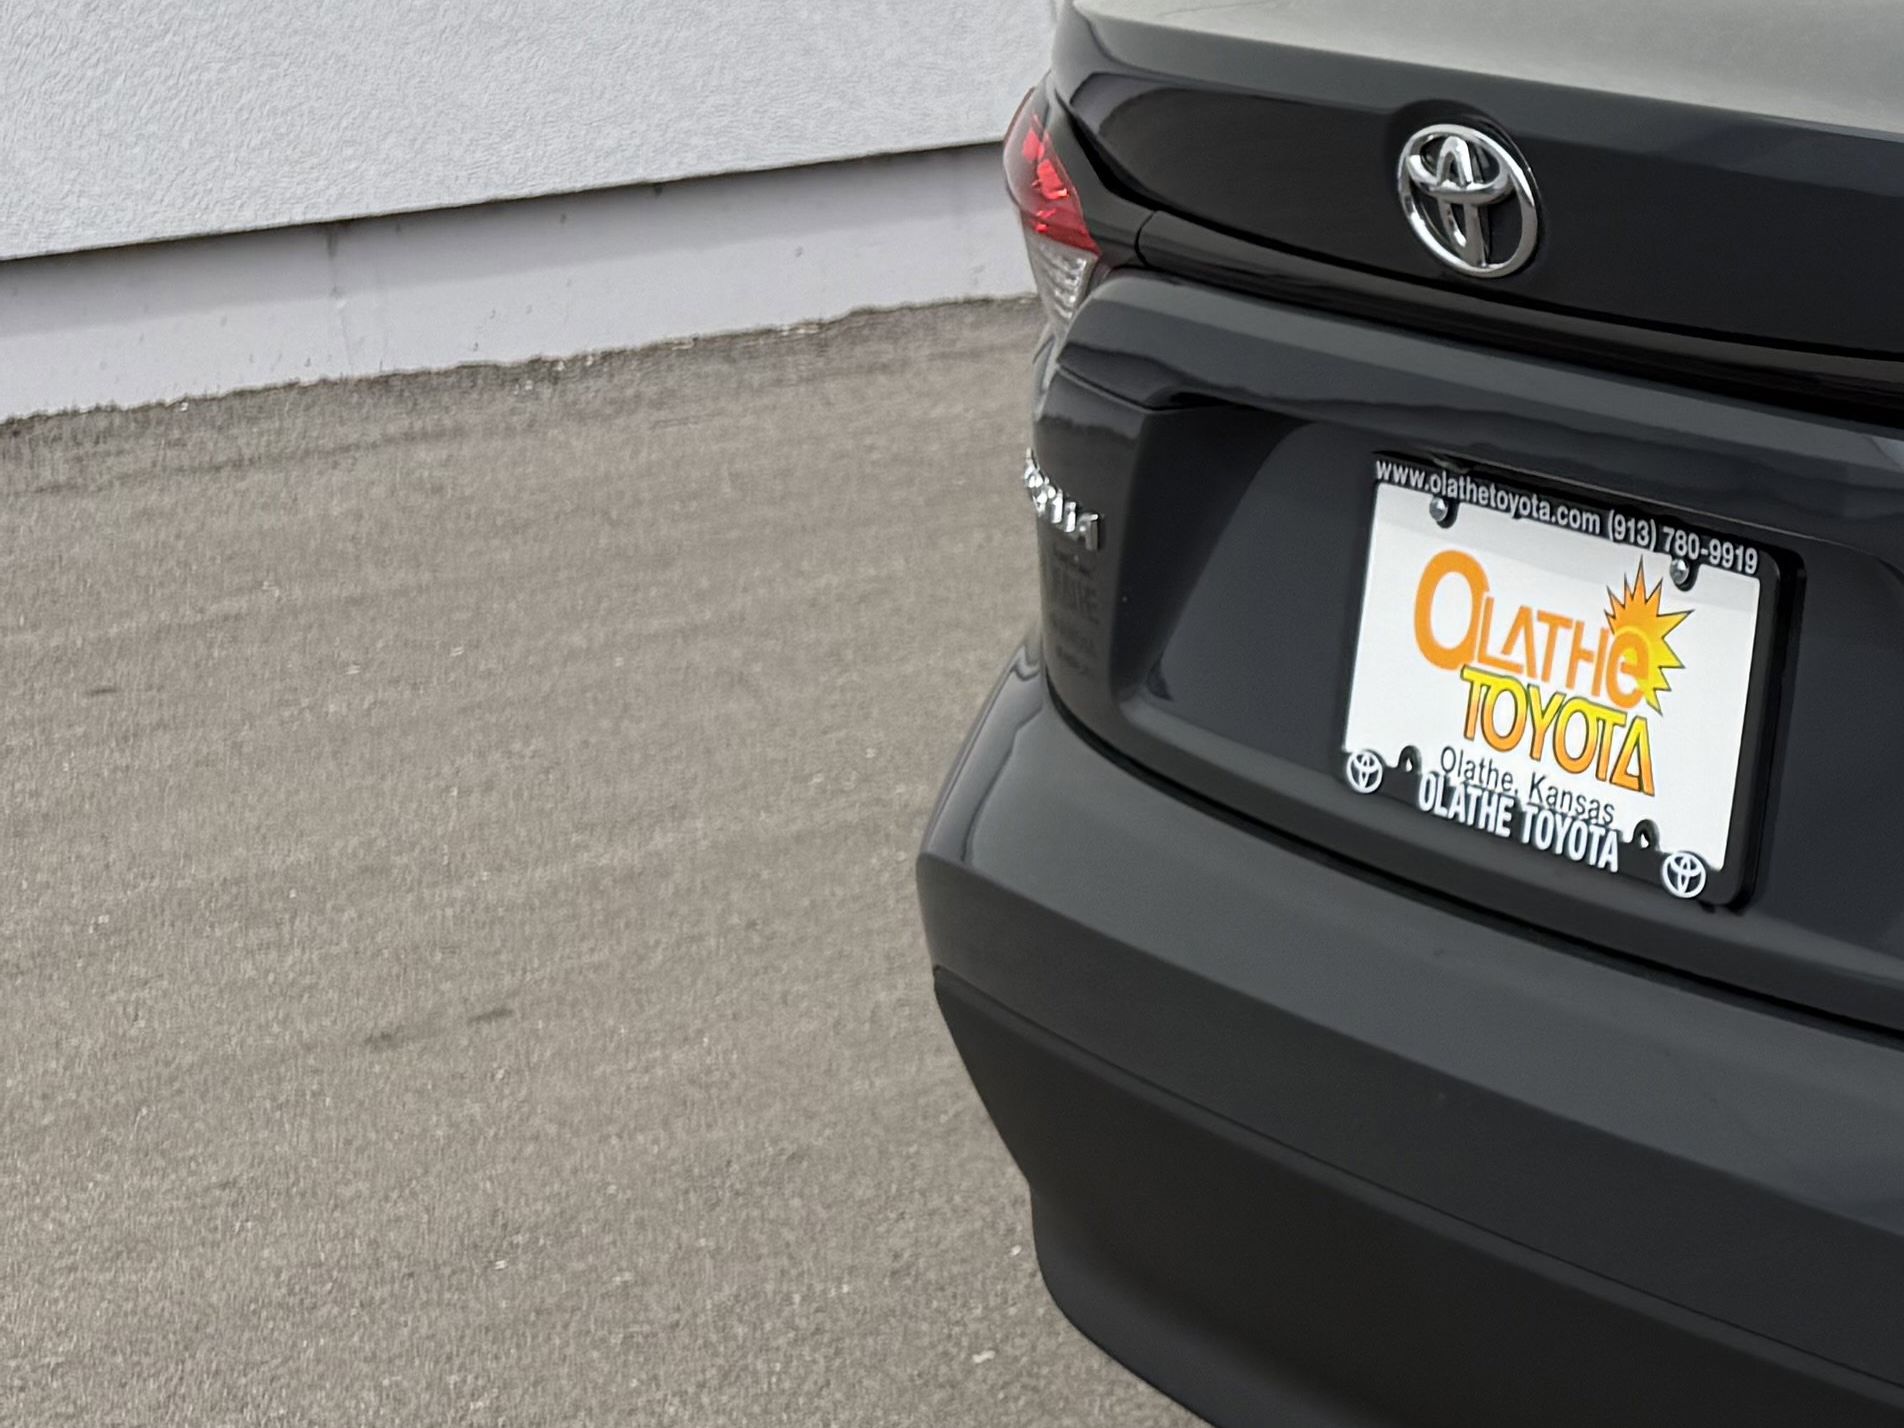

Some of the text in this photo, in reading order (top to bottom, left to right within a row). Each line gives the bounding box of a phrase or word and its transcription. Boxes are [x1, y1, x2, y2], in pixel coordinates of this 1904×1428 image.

[1375, 459, 1759, 575] www.olathetoyota.com (913) 780-9919
[1460, 664, 1656, 797] TOYOTA
[1418, 772, 1620, 873] OLATHE TOYOTA
[1528, 771, 1616, 826] Kansas
